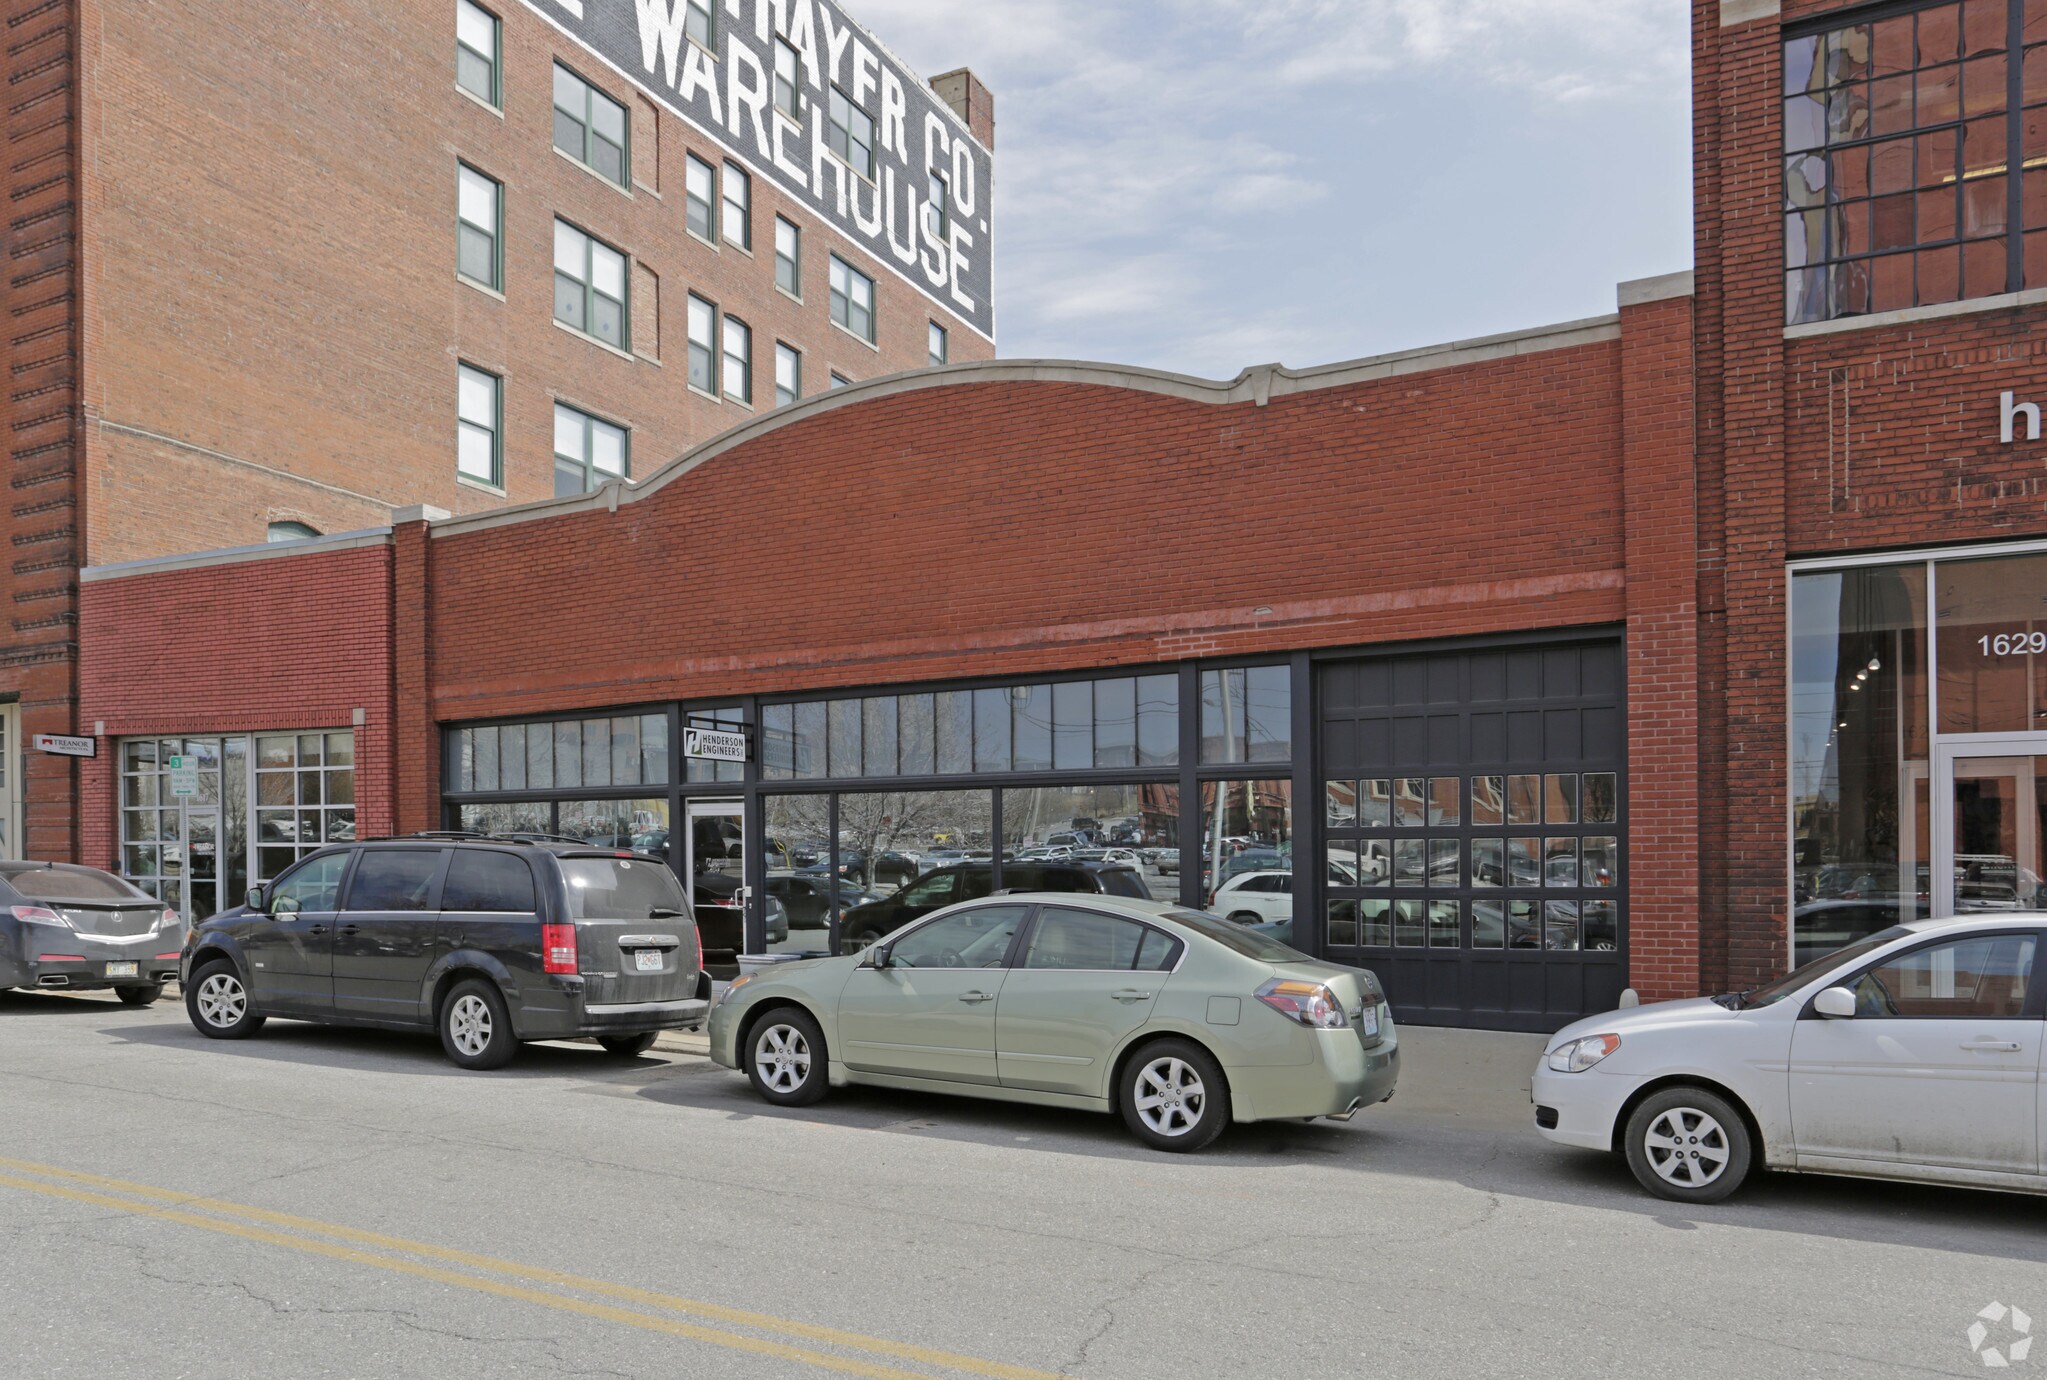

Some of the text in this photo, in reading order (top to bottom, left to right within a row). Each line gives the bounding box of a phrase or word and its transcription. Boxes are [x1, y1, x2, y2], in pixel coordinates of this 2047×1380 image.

[725, 0, 907, 165] AYER
[634, 0, 976, 313] WAREHOUSE
[2000, 391, 2041, 443] h
[1977, 632, 2047, 656] 1629
[54, 739, 89, 748] TREANOR
[702, 734, 744, 747] HENDERSON
[703, 744, 741, 757] ENGINEERS
